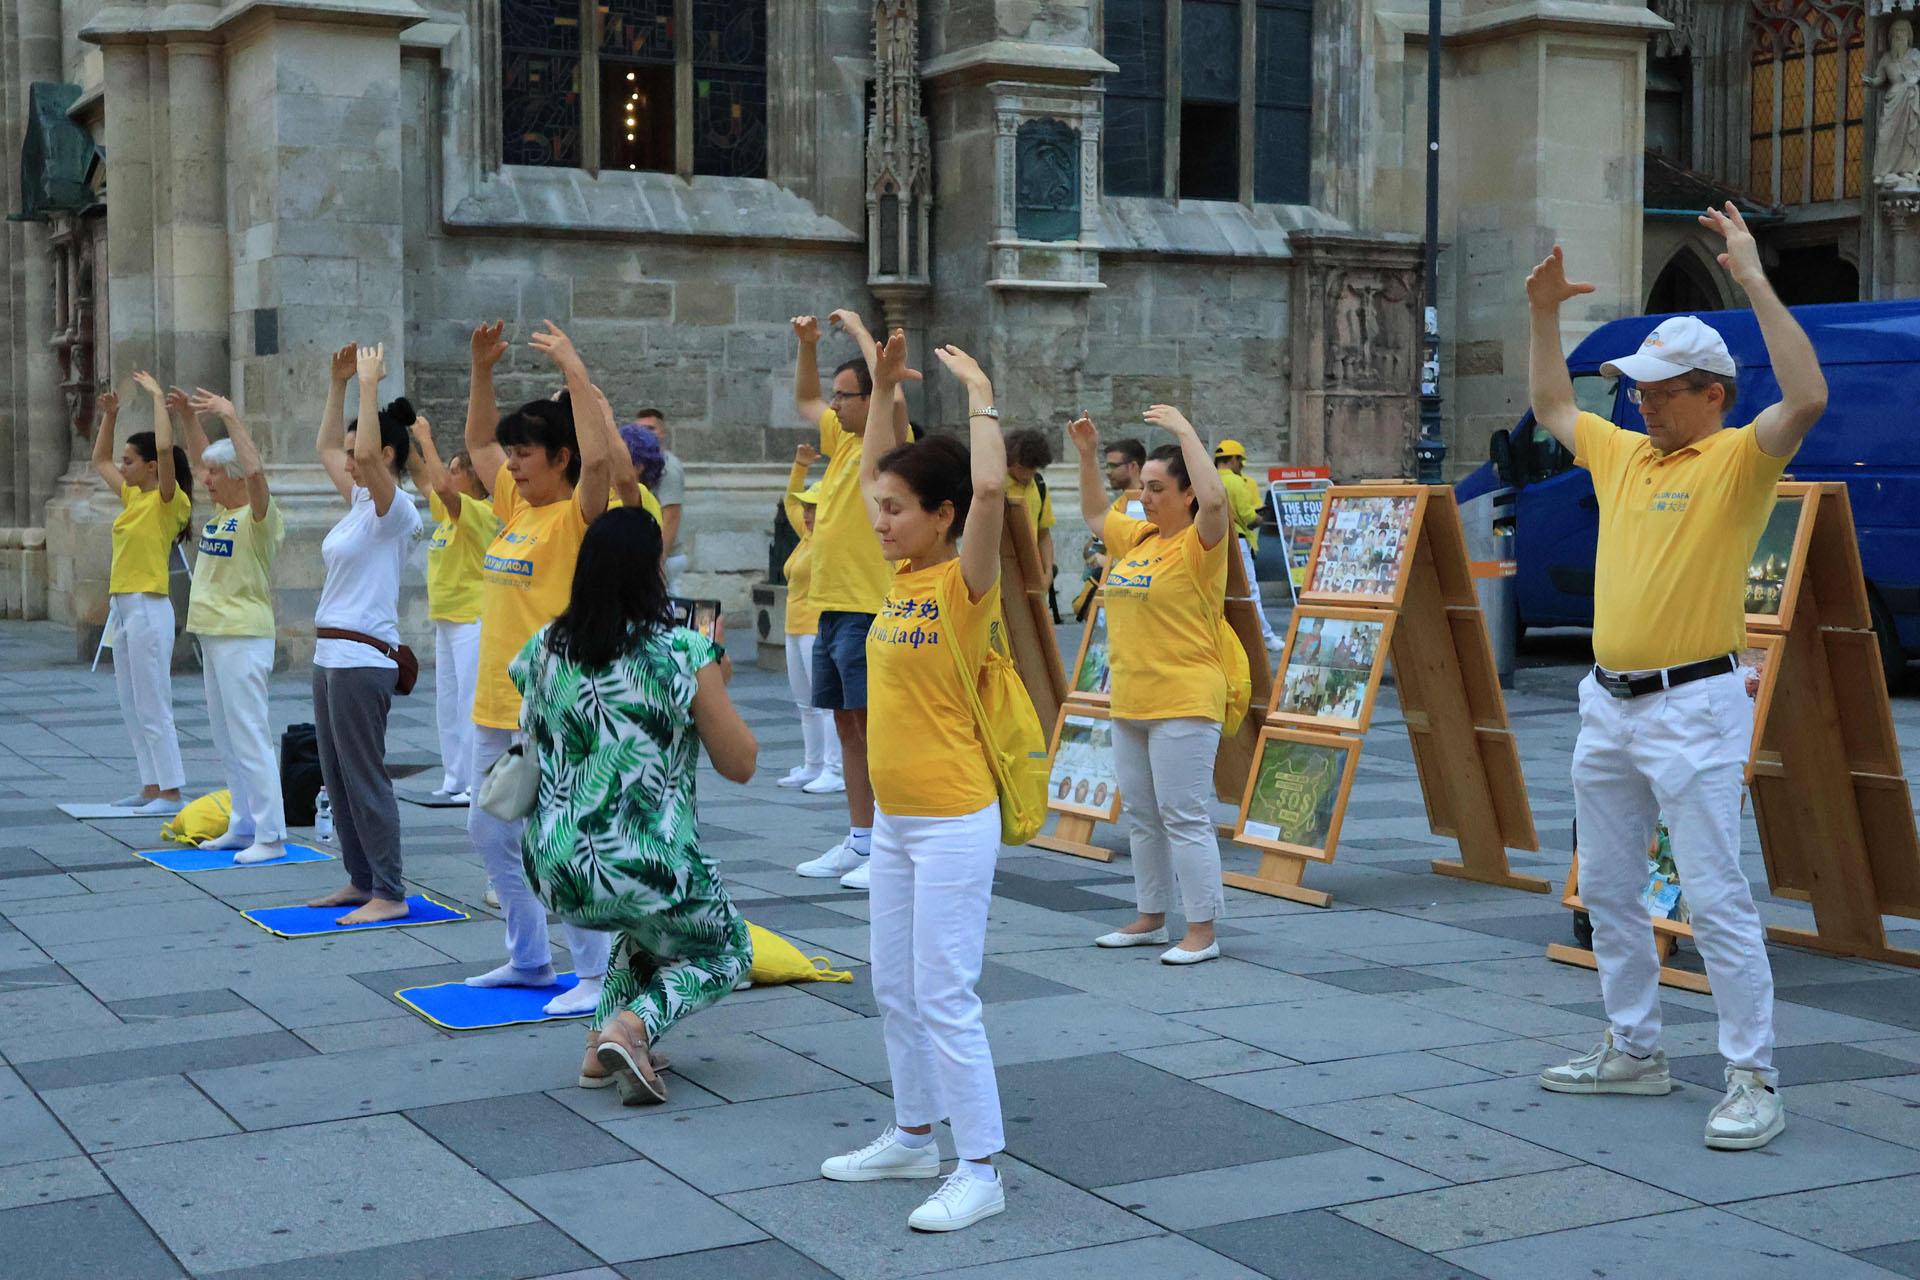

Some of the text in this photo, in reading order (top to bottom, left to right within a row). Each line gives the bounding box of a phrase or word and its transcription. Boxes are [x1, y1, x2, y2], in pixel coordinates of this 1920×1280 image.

[1671, 492, 1689, 500] DAFA
[1282, 501, 1323, 514] THE FOU
[1284, 514, 1321, 527] SEASO
[888, 626, 939, 649] Дафа
[1276, 789, 1312, 813] SOS
